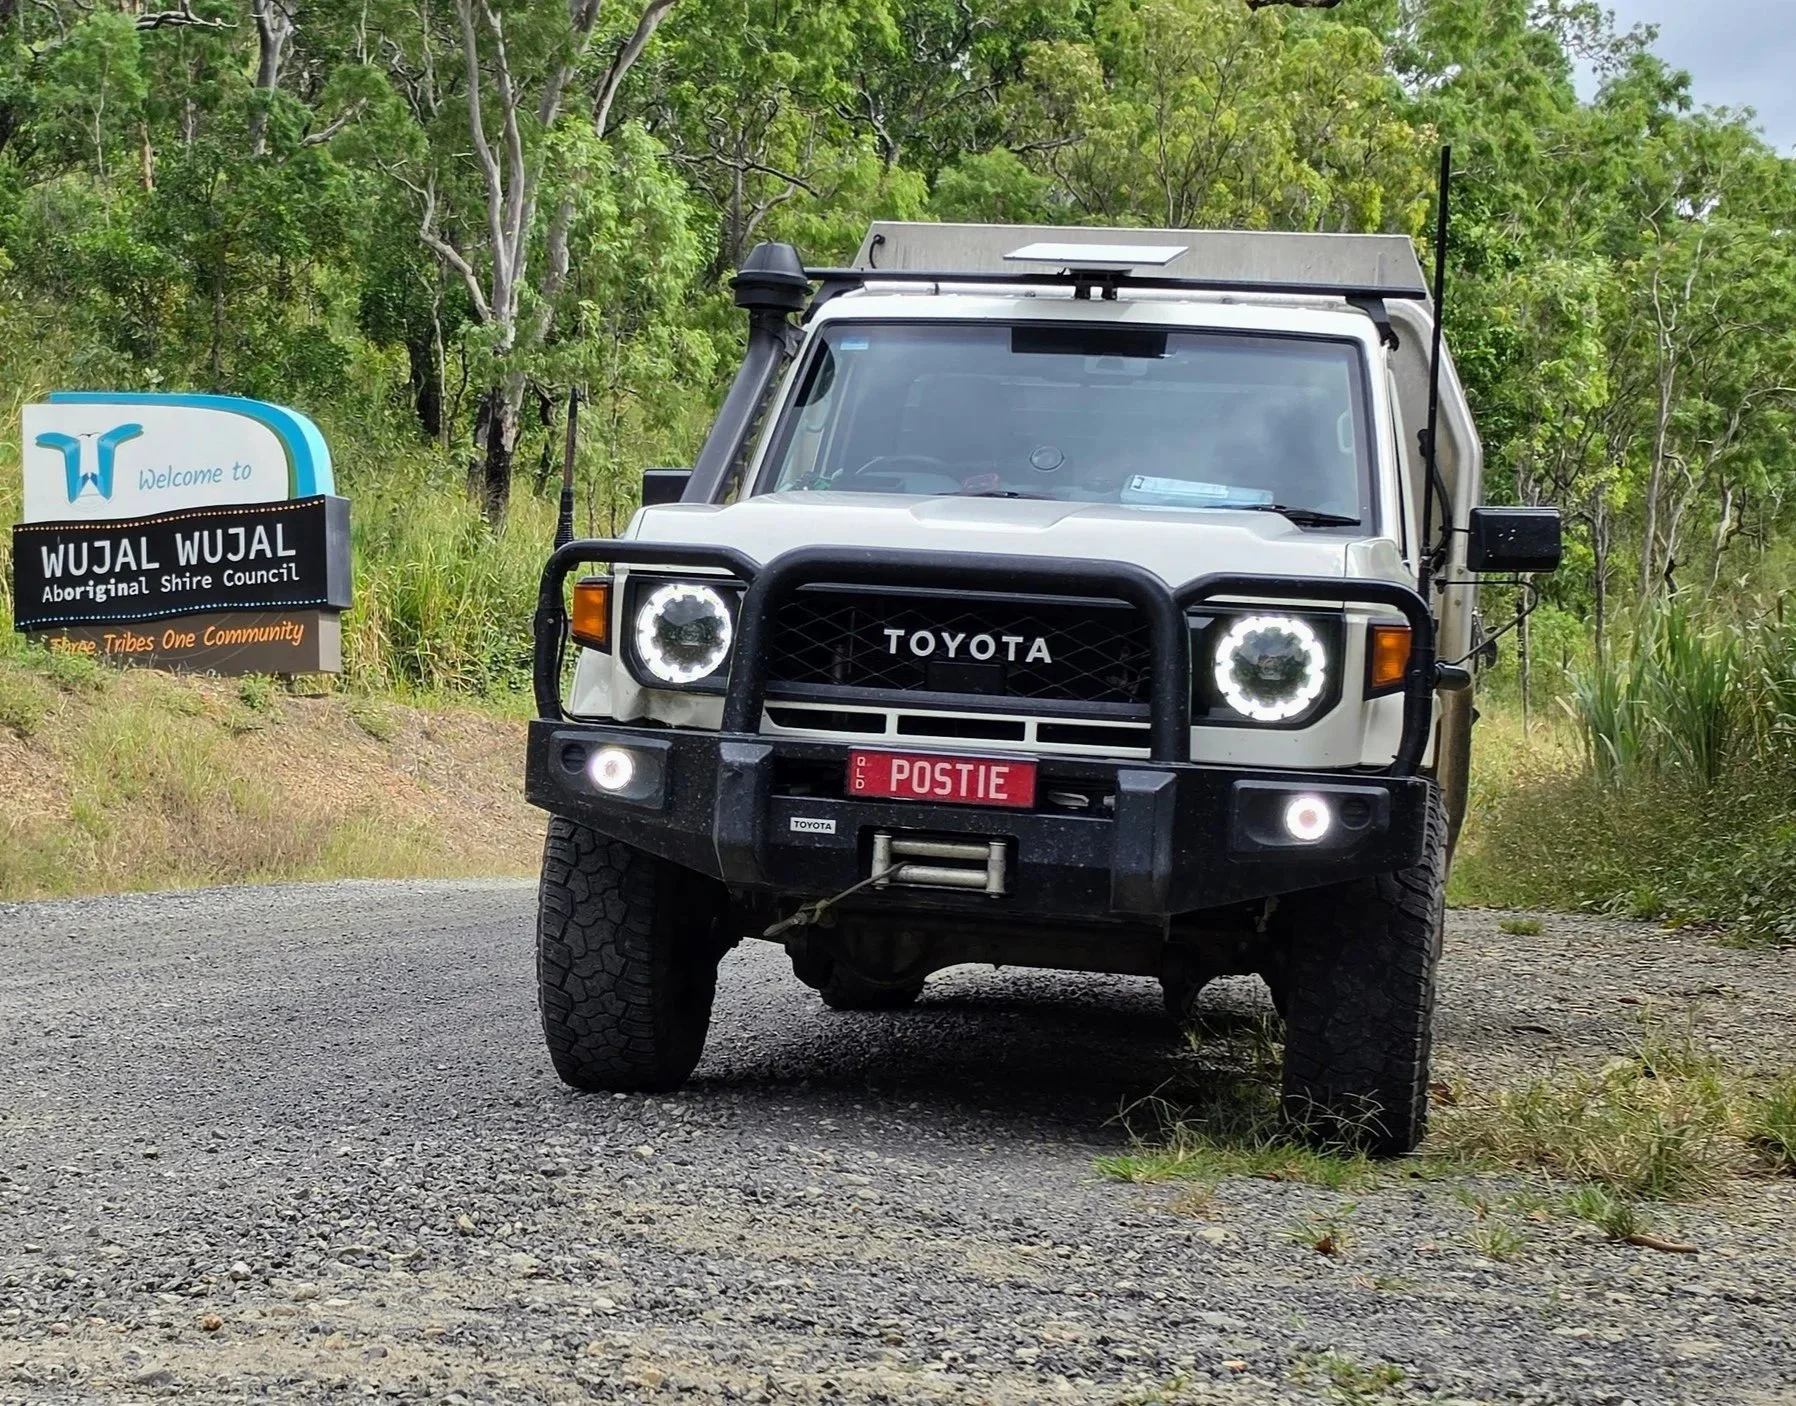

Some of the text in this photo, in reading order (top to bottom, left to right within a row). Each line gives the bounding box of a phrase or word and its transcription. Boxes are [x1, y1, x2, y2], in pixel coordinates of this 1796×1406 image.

[139, 461, 251, 491] Welcome to
[41, 523, 296, 579] WUJAL WUJAL
[42, 563, 300, 604] Aboriginal Shire Council
[104, 631, 154, 654] Tribes
[162, 624, 195, 649] One
[204, 622, 304, 646] Community
[883, 628, 1052, 664] TOYOTA
[890, 758, 1009, 799] POSTIE
[794, 820, 832, 831] TOYOTA
